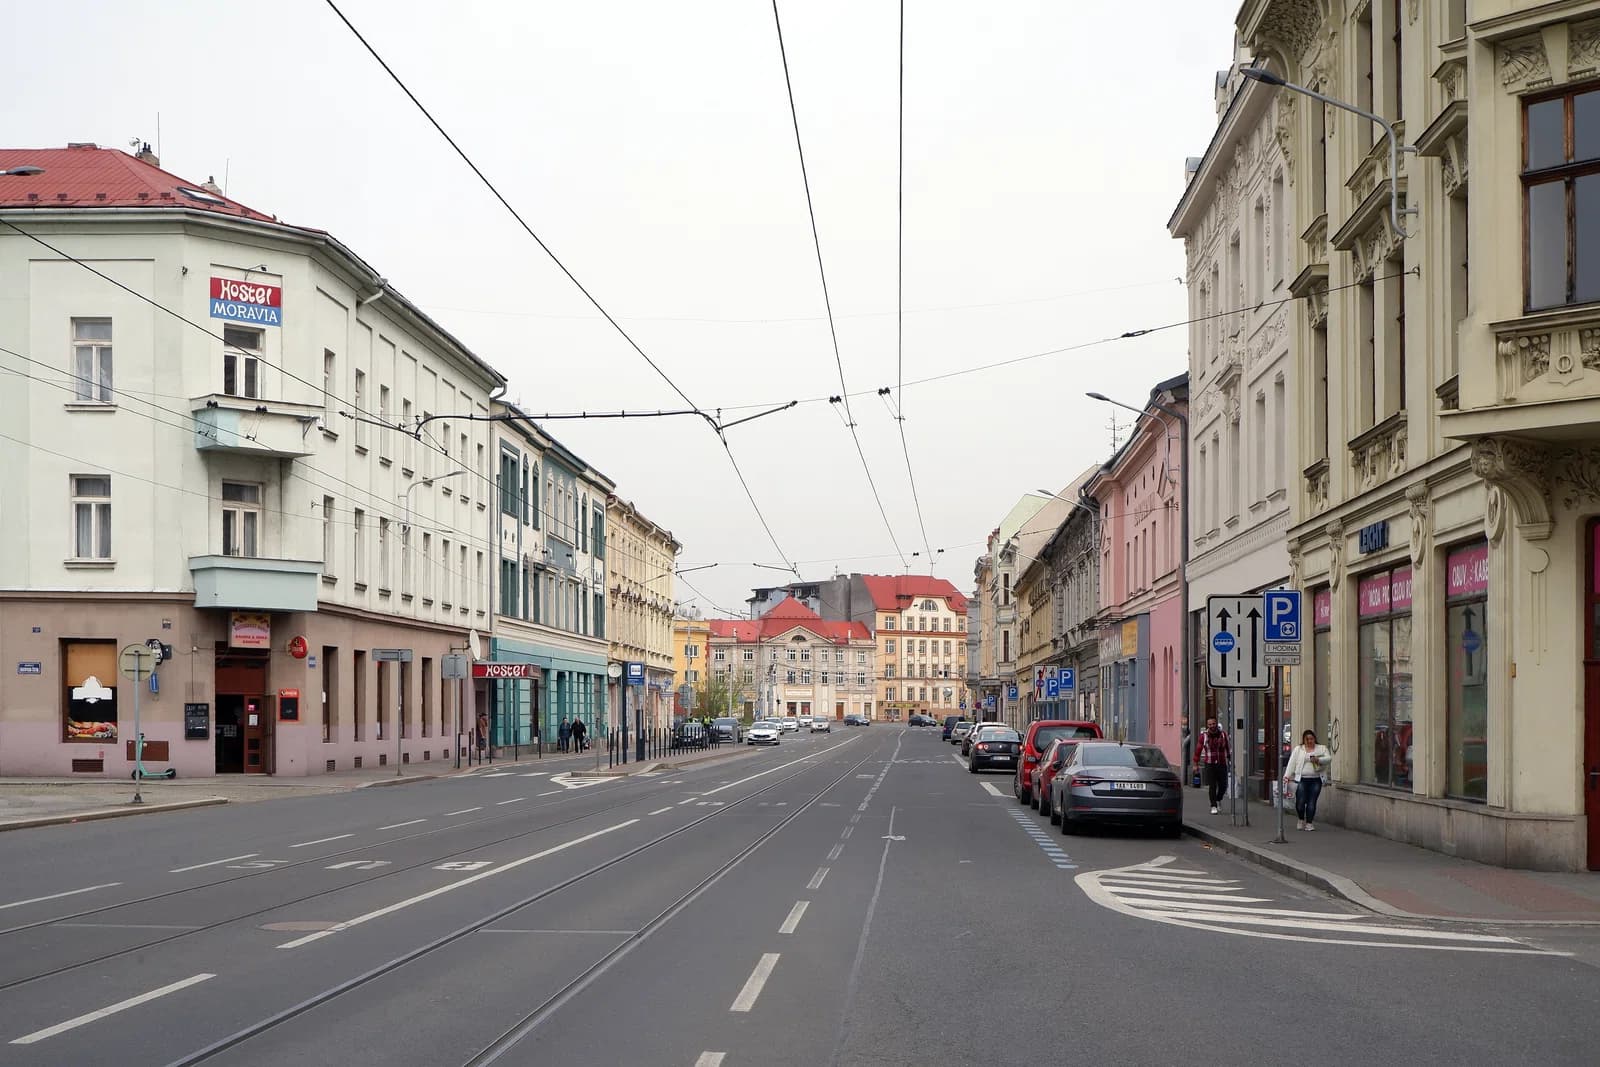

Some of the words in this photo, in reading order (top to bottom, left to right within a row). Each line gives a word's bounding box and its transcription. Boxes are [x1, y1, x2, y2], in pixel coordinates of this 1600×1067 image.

[220, 280, 272, 304] Hostel
[213, 302, 278, 322] MORAVIA
[1271, 597, 1293, 626] P
[485, 664, 526, 678] Hostel
[1062, 671, 1072, 684] P
[1049, 679, 1058, 692] P
